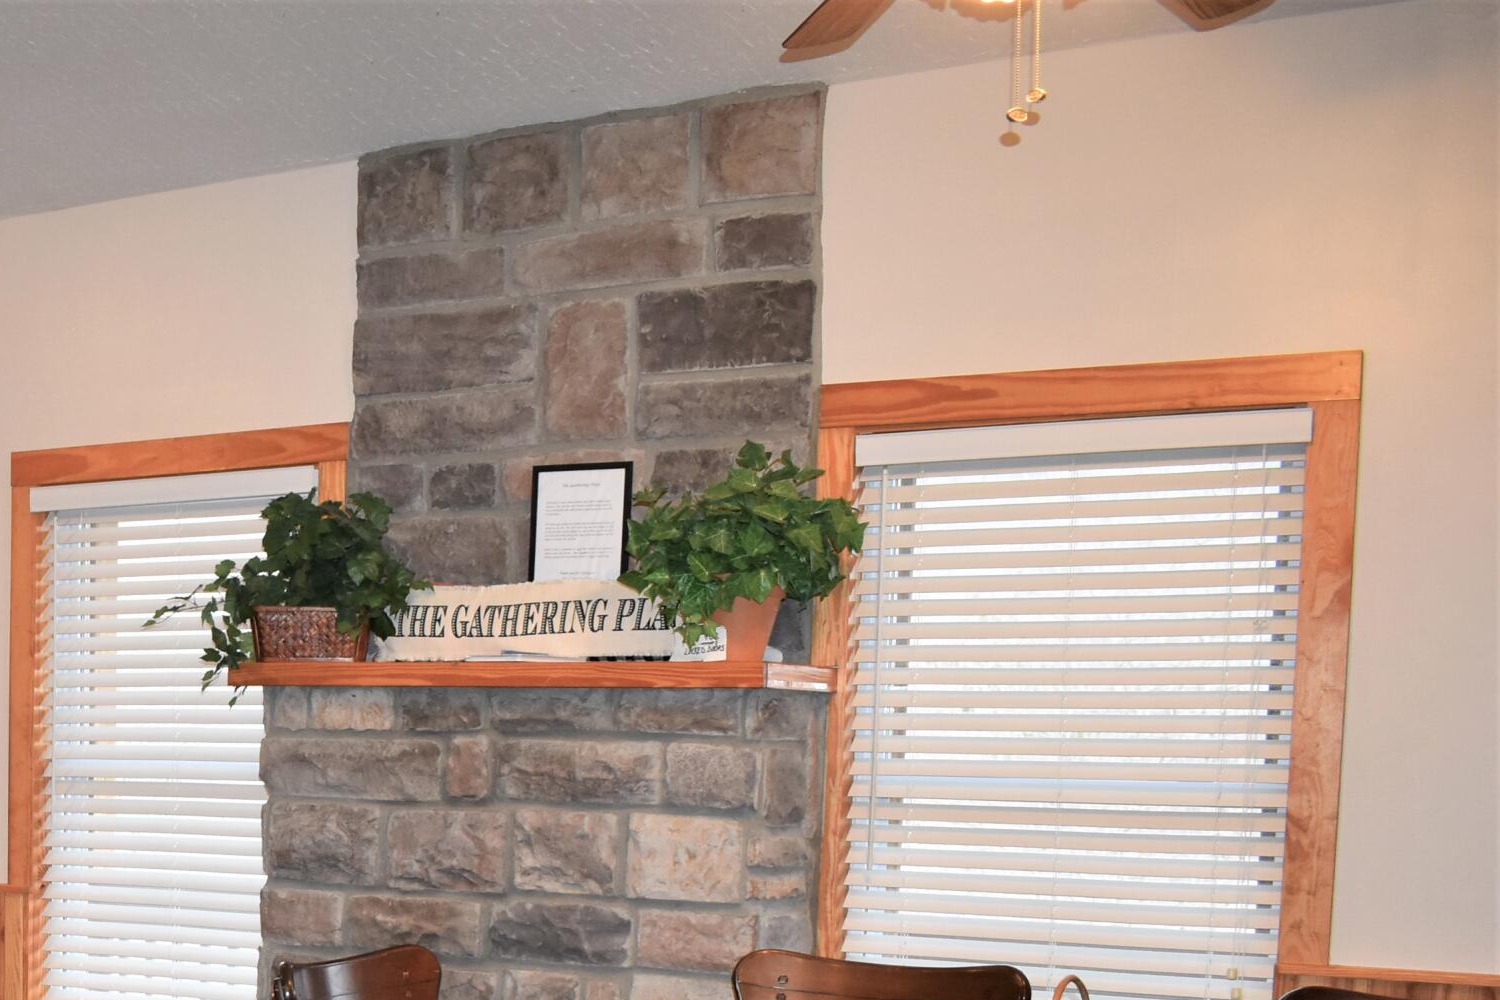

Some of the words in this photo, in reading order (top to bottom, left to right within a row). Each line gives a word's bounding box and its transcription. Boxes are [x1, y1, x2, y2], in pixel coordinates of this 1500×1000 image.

[395, 604, 448, 638] THE
[451, 598, 608, 639] GATHERING
[612, 597, 678, 632] PLA
